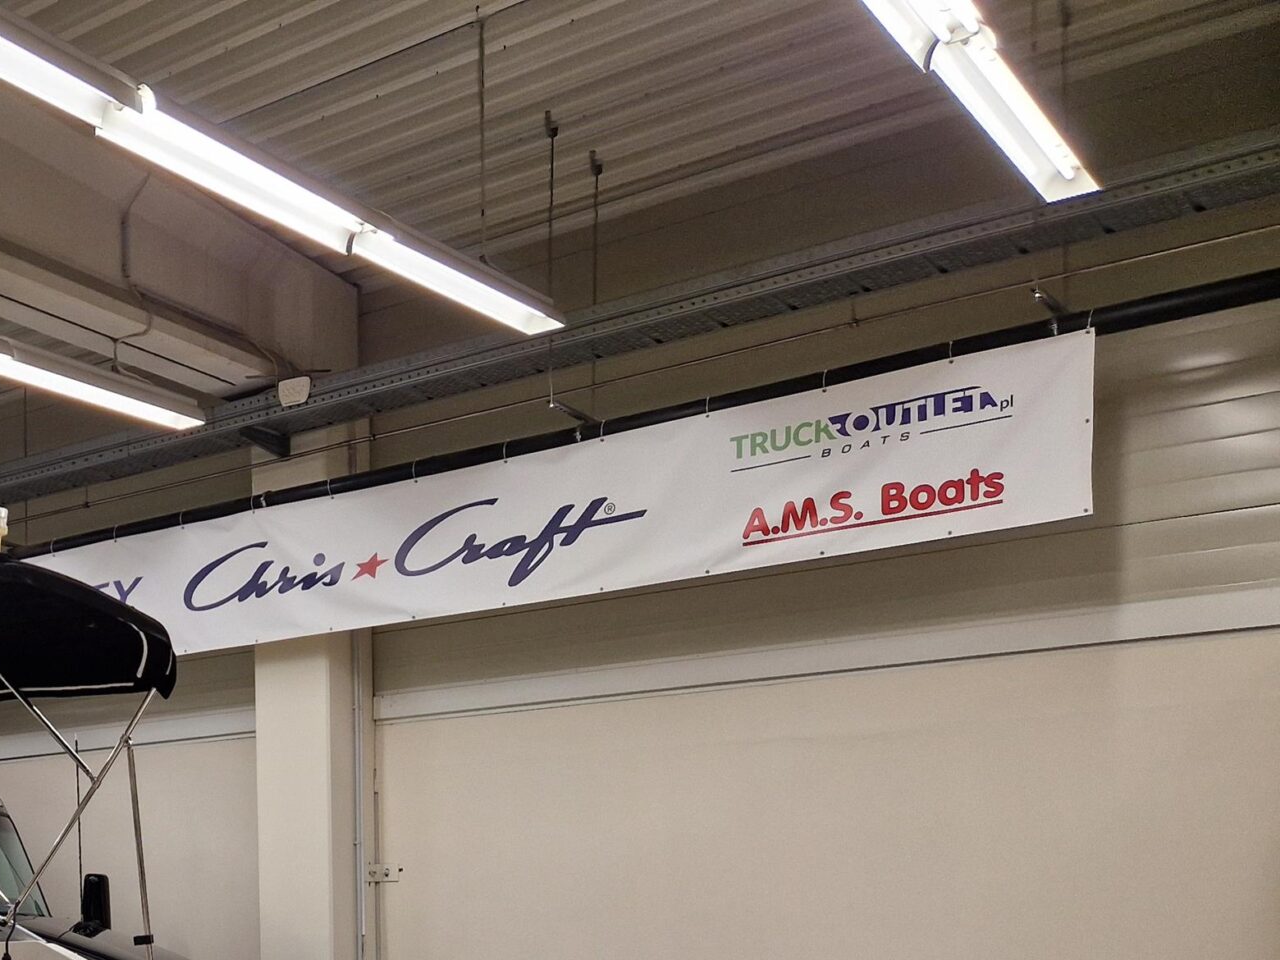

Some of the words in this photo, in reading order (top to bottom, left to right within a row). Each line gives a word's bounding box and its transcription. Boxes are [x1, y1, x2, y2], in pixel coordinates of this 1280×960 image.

[821, 431, 910, 458] BOATS
[742, 490, 864, 540] A.M.S.
[881, 468, 1005, 516] Boats
[183, 541, 346, 612] Chris
